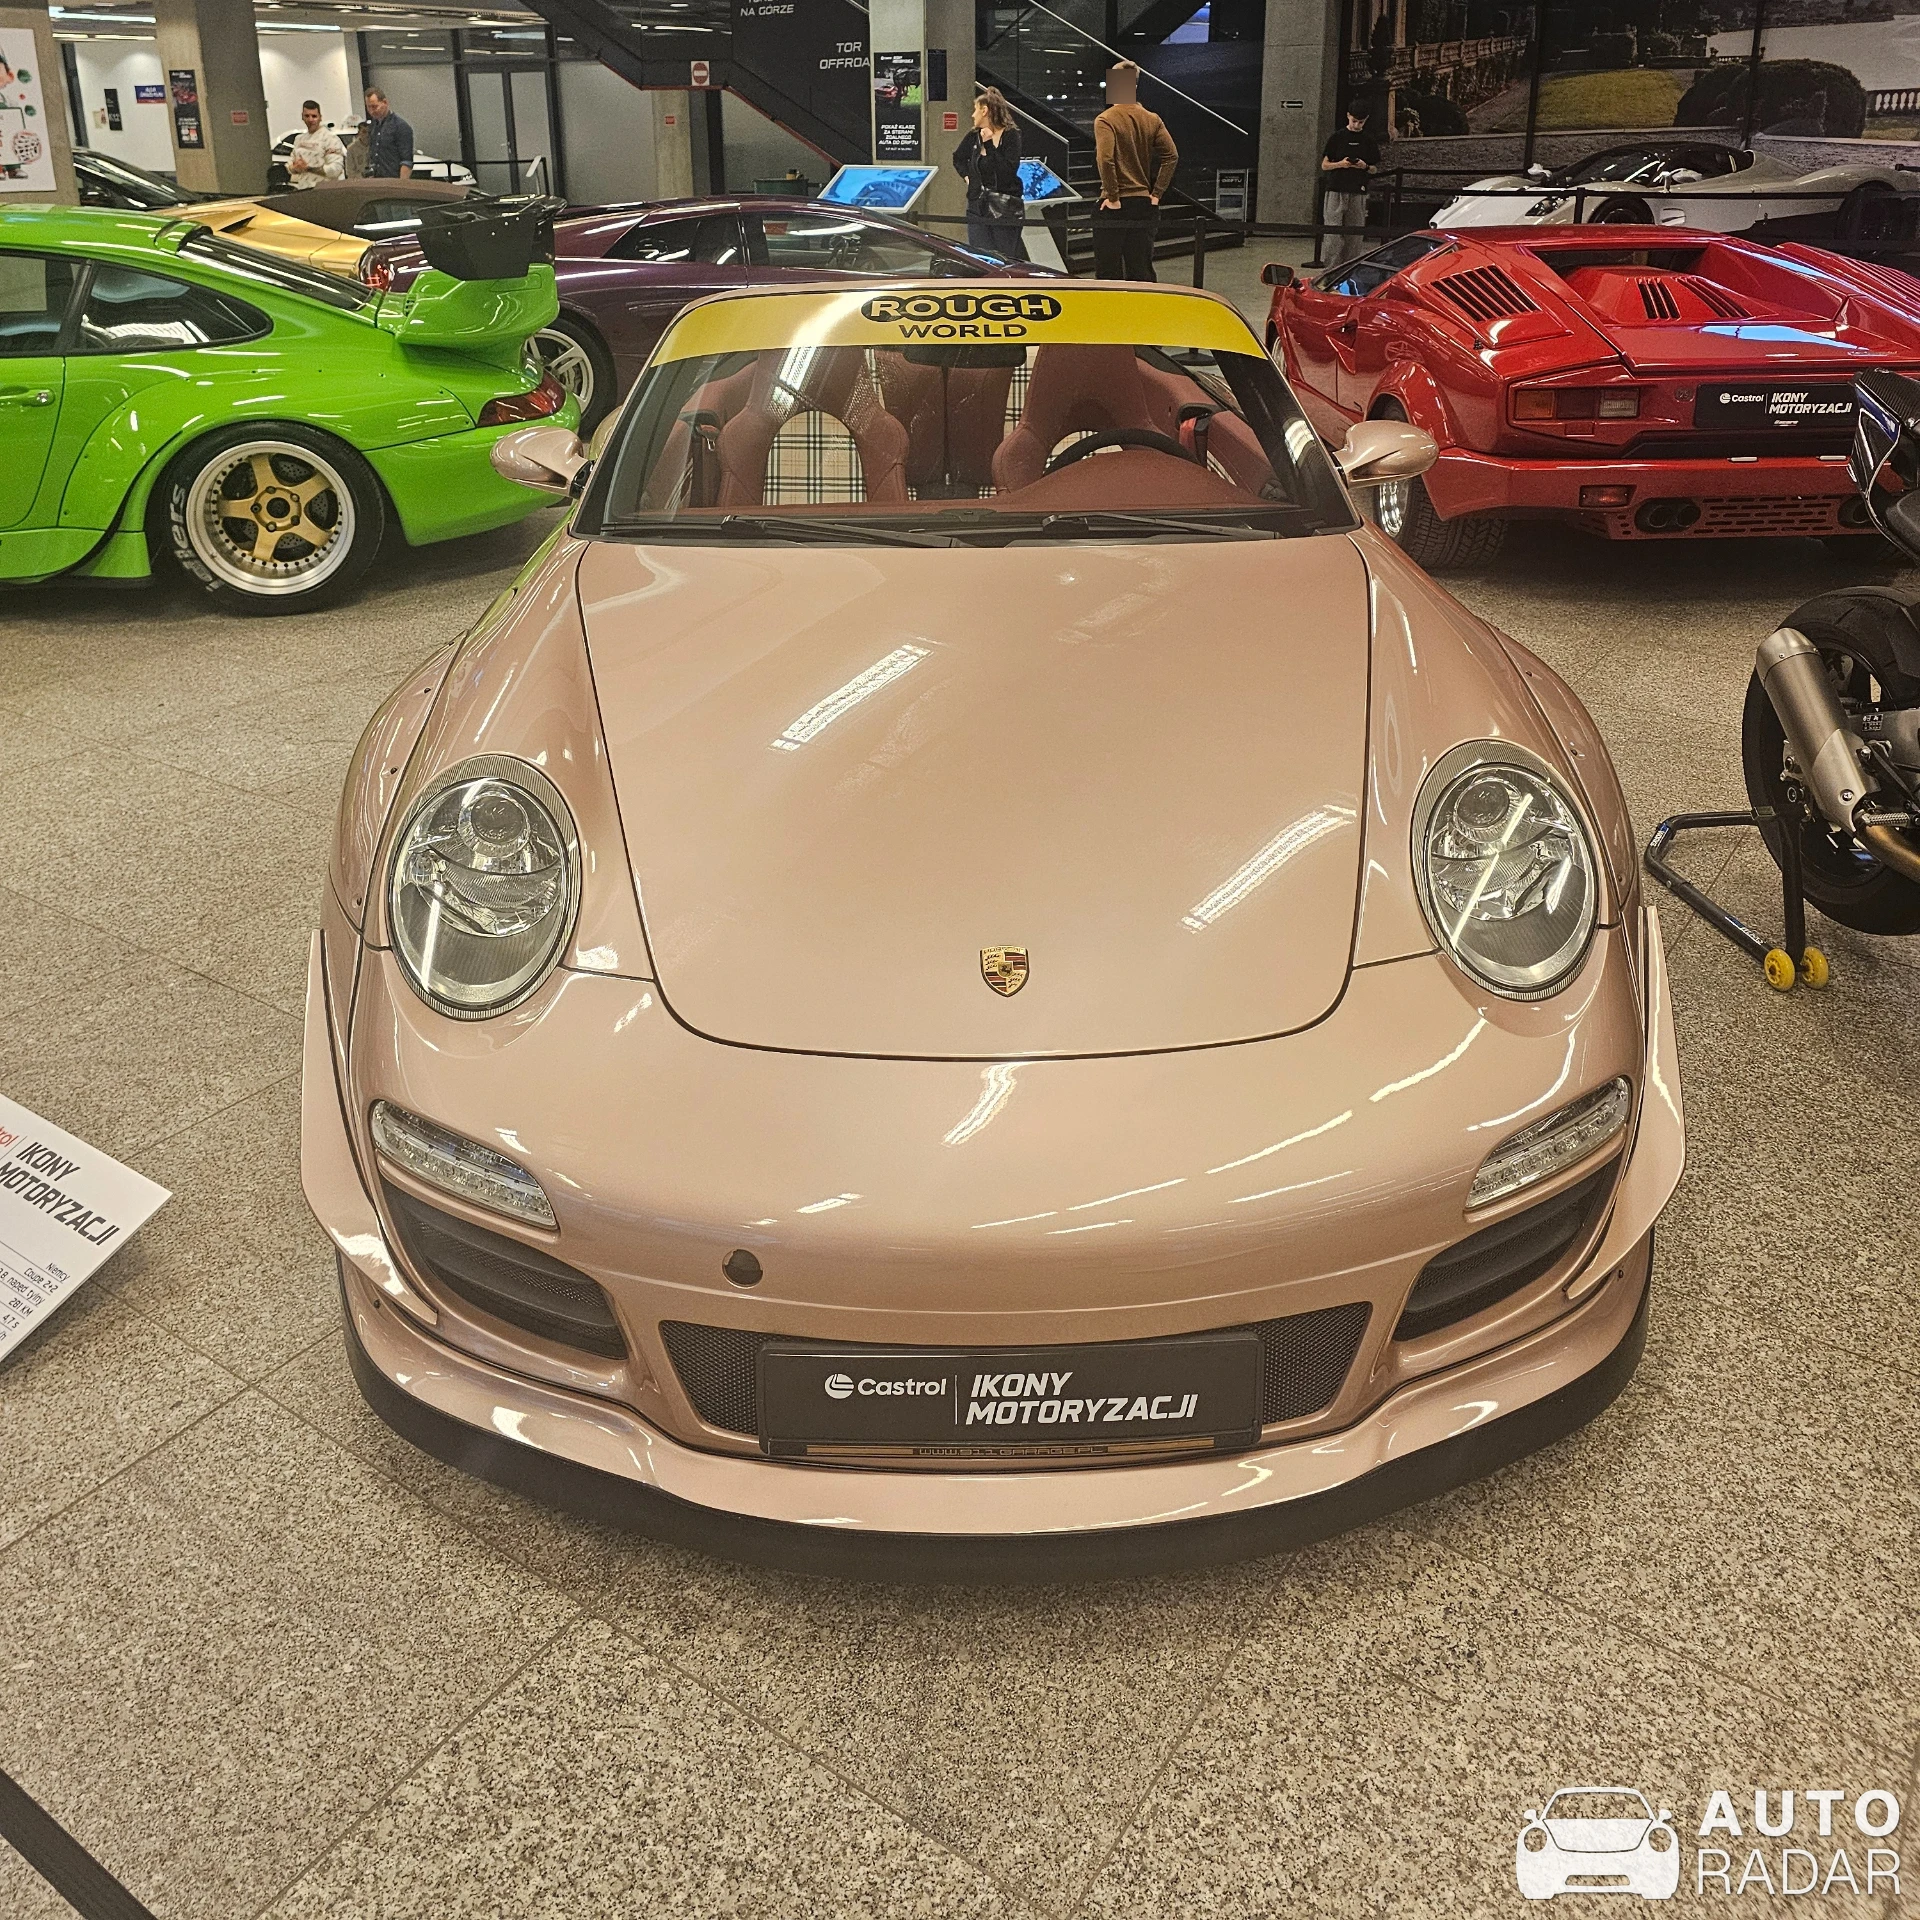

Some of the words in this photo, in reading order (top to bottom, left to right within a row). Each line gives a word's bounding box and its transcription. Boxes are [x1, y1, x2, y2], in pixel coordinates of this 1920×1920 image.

[740, 7, 755, 17] NA
[758, 4, 795, 15] GÓRZE
[836, 42, 862, 53] TOR
[869, 298, 1054, 318] ROUGH
[899, 324, 1027, 338] WORLD
[1731, 394, 1764, 403] Castrol
[1771, 392, 1808, 403] IKONY
[1769, 403, 1852, 414] MOTORYZACJI
[15, 1141, 81, 1182] IKONY
[0, 1161, 120, 1246] MOTORYZACJI
[23, 1267, 44, 1284] Coupe
[42, 1280, 59, 1293] 2+2
[45, 1262, 71, 1282] Niemcy
[6, 1277, 29, 1293] napęd
[26, 1289, 46, 1307] tylny
[8, 1298, 23, 1310] 281
[20, 1305, 34, 1317] KM
[857, 1378, 946, 1396] Castrol
[970, 1372, 1073, 1397] IKONY
[966, 1394, 1199, 1425] MOTORYZACJI
